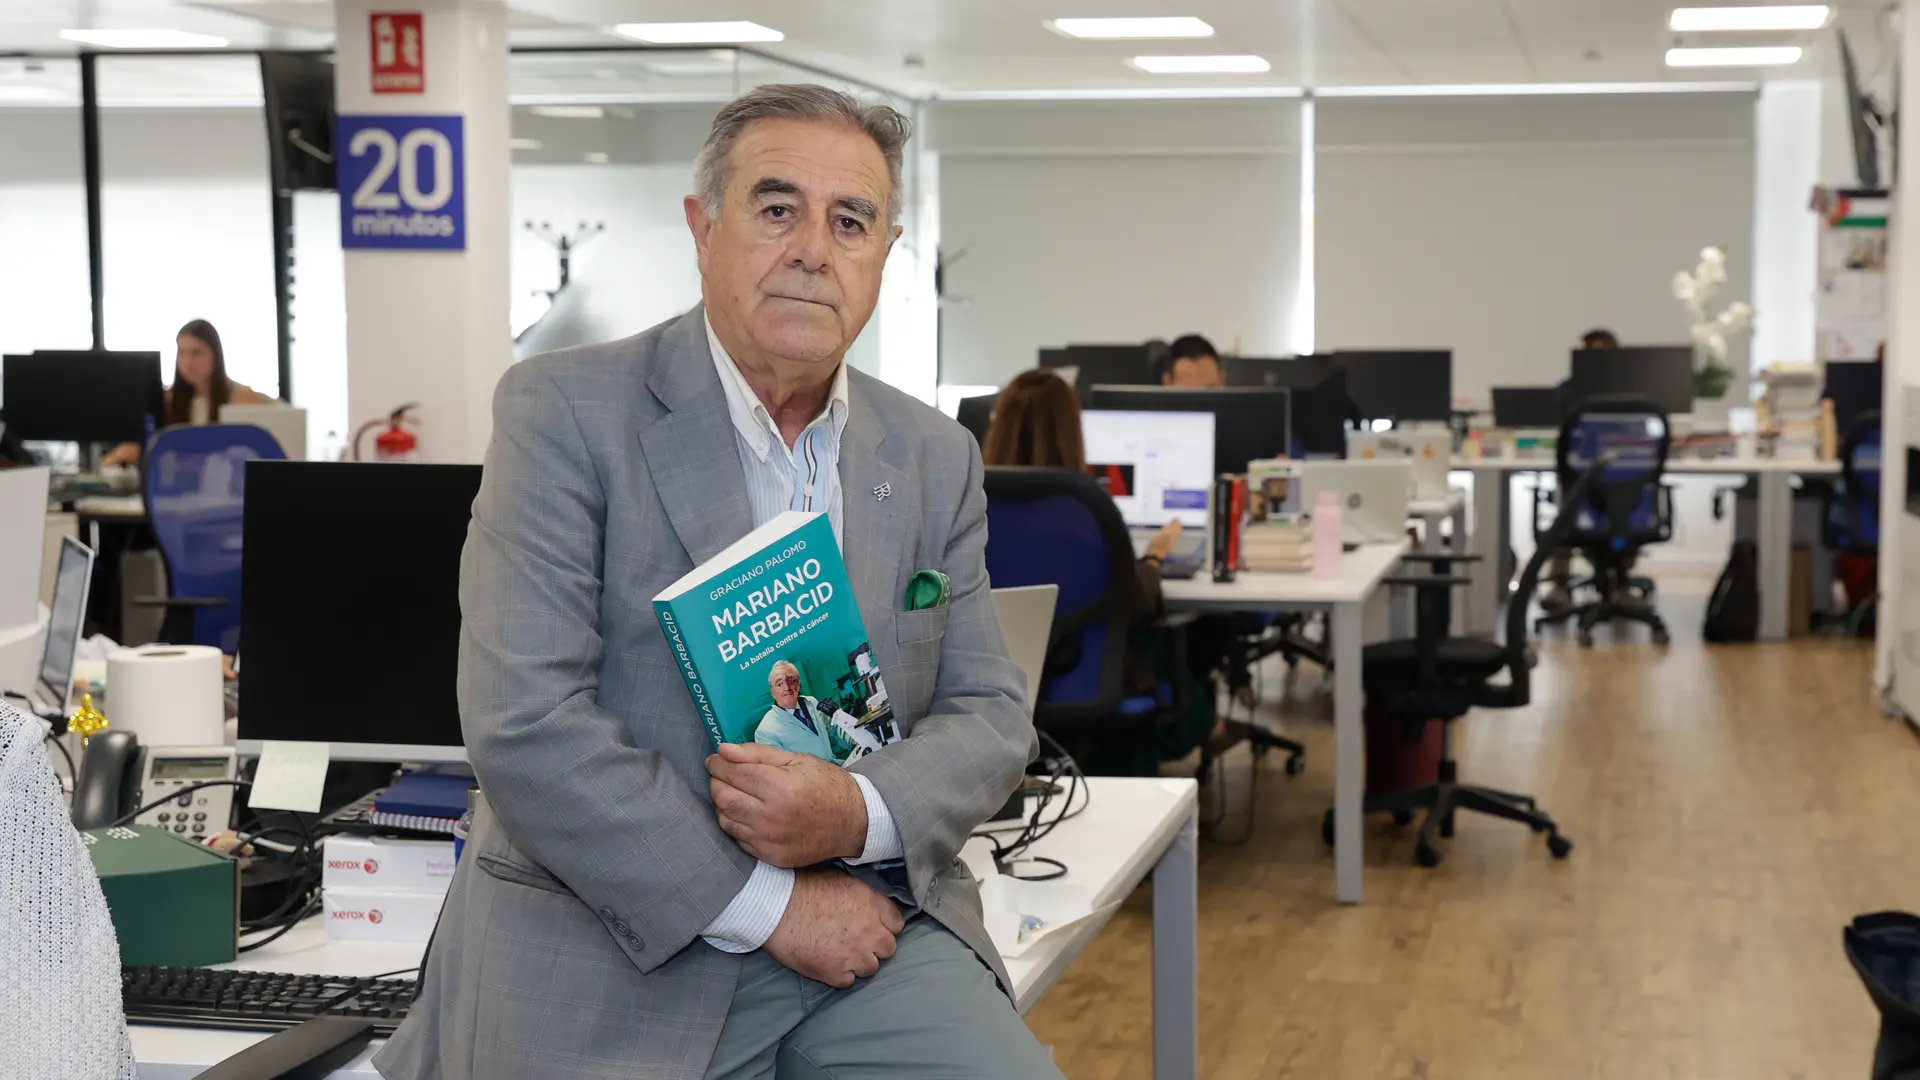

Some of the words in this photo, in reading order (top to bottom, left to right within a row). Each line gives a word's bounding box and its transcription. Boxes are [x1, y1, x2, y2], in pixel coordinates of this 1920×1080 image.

[349, 127, 453, 211] 20
[352, 209, 455, 237] minutos
[709, 565, 764, 601] GRACIANO
[764, 540, 807, 570] PALOMO
[711, 558, 821, 635] MARIANO
[663, 611, 697, 680] BARBACID
[717, 581, 834, 663] BARBACID
[739, 661, 750, 671] La
[750, 645, 775, 664] batalla
[775, 632, 799, 649] contra
[799, 627, 807, 635] el
[806, 612, 829, 630] cáncer
[328, 860, 361, 870] xerox
[332, 910, 366, 920] xerox
